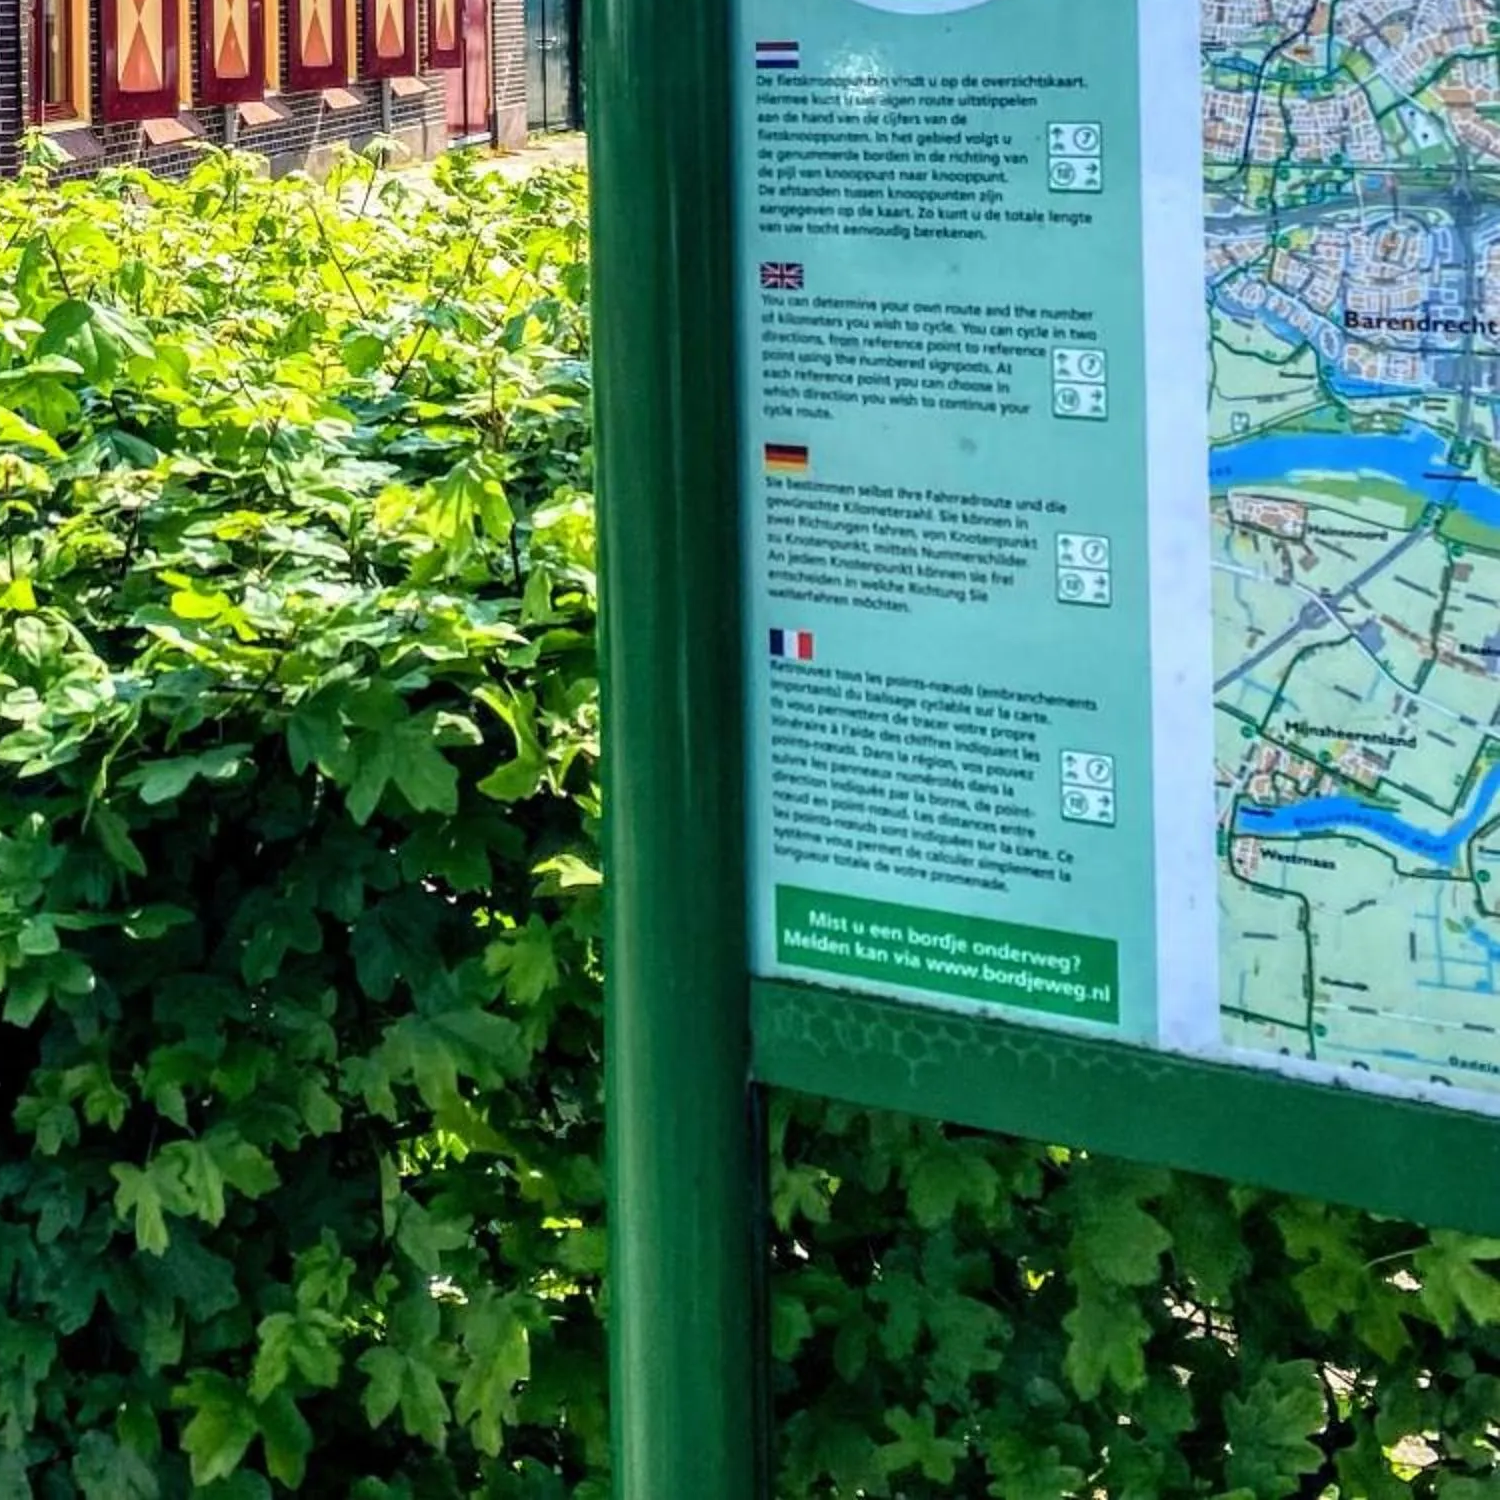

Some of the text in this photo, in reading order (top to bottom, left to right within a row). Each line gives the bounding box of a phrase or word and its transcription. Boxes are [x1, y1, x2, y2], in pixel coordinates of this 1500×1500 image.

[1344, 311, 1500, 336] Barendrecht
[784, 929, 1110, 1002] Melden kan via www.bordjeweg.nl
[809, 911, 1081, 973] Mist u een bordje onderweg?
